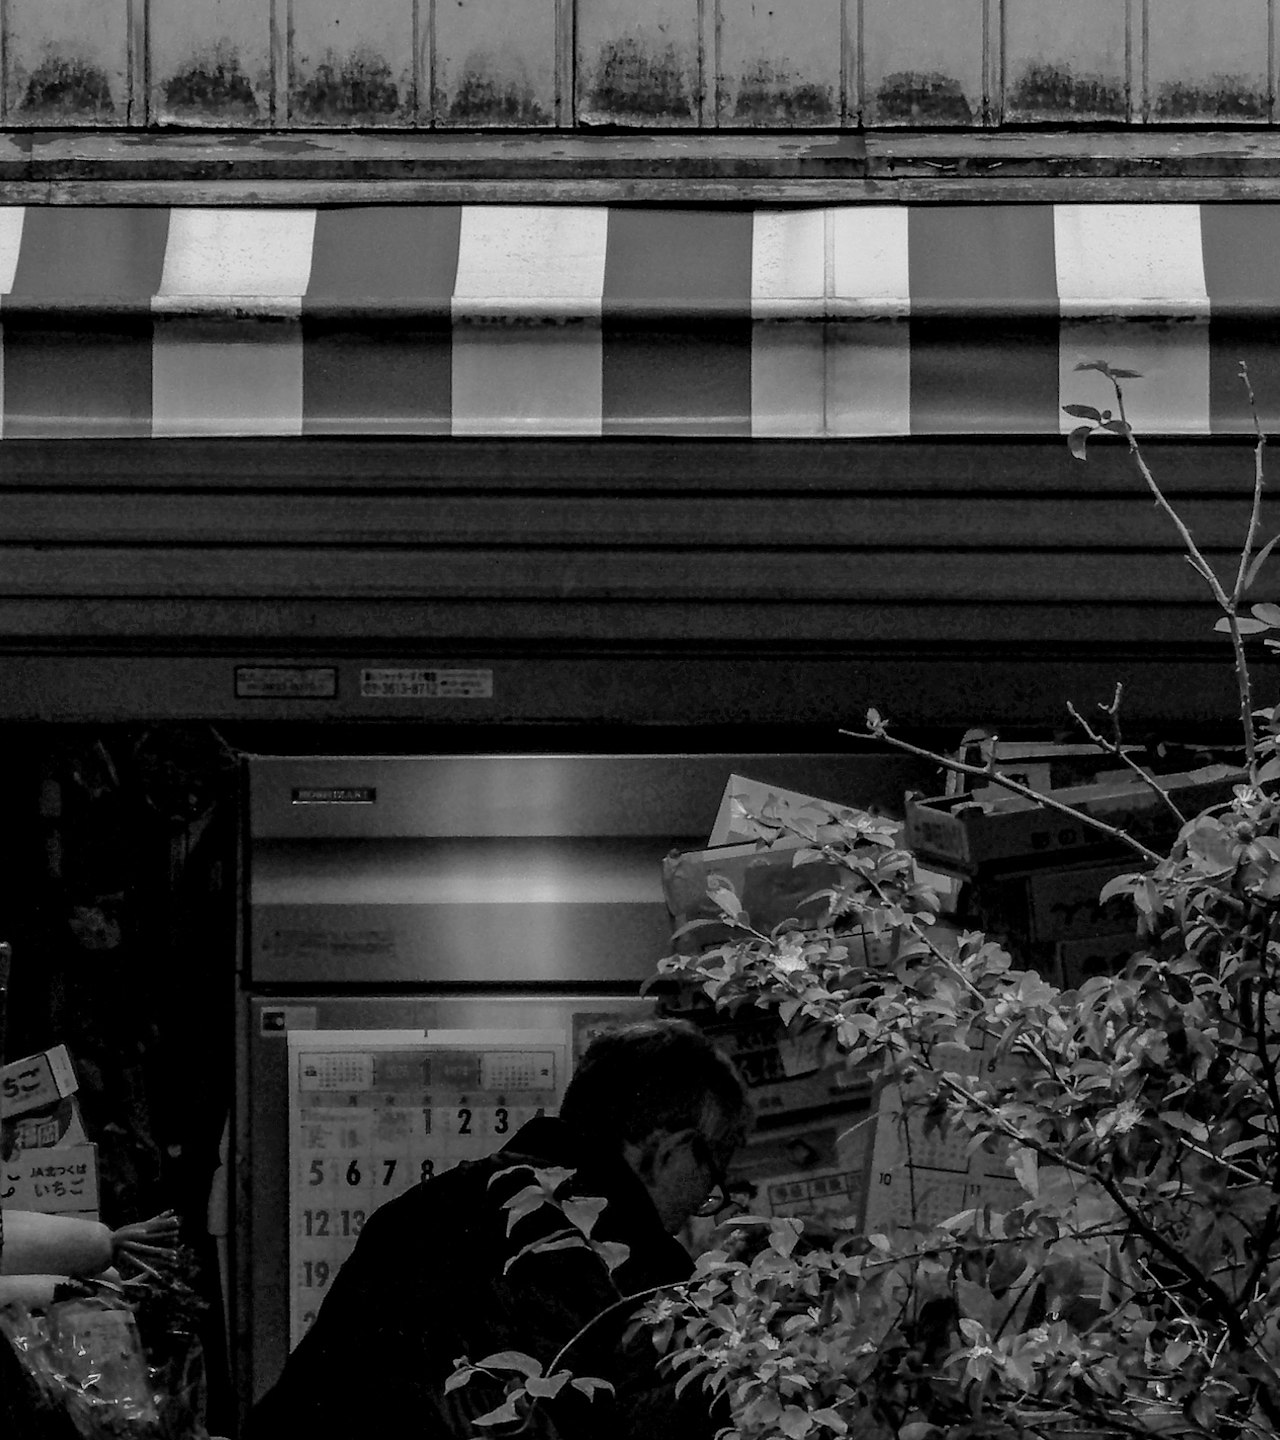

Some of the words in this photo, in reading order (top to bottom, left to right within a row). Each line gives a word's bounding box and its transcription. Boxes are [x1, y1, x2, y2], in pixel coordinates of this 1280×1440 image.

[457, 1108, 472, 1135] 2
[494, 1108, 509, 1134] 3
[309, 1160, 324, 1186] 5
[346, 1160, 361, 1186] 6
[382, 1160, 397, 1186] 7
[34, 1178, 84, 1198] いちご
[303, 1211, 329, 1237] 12
[303, 1262, 329, 1288] 19
